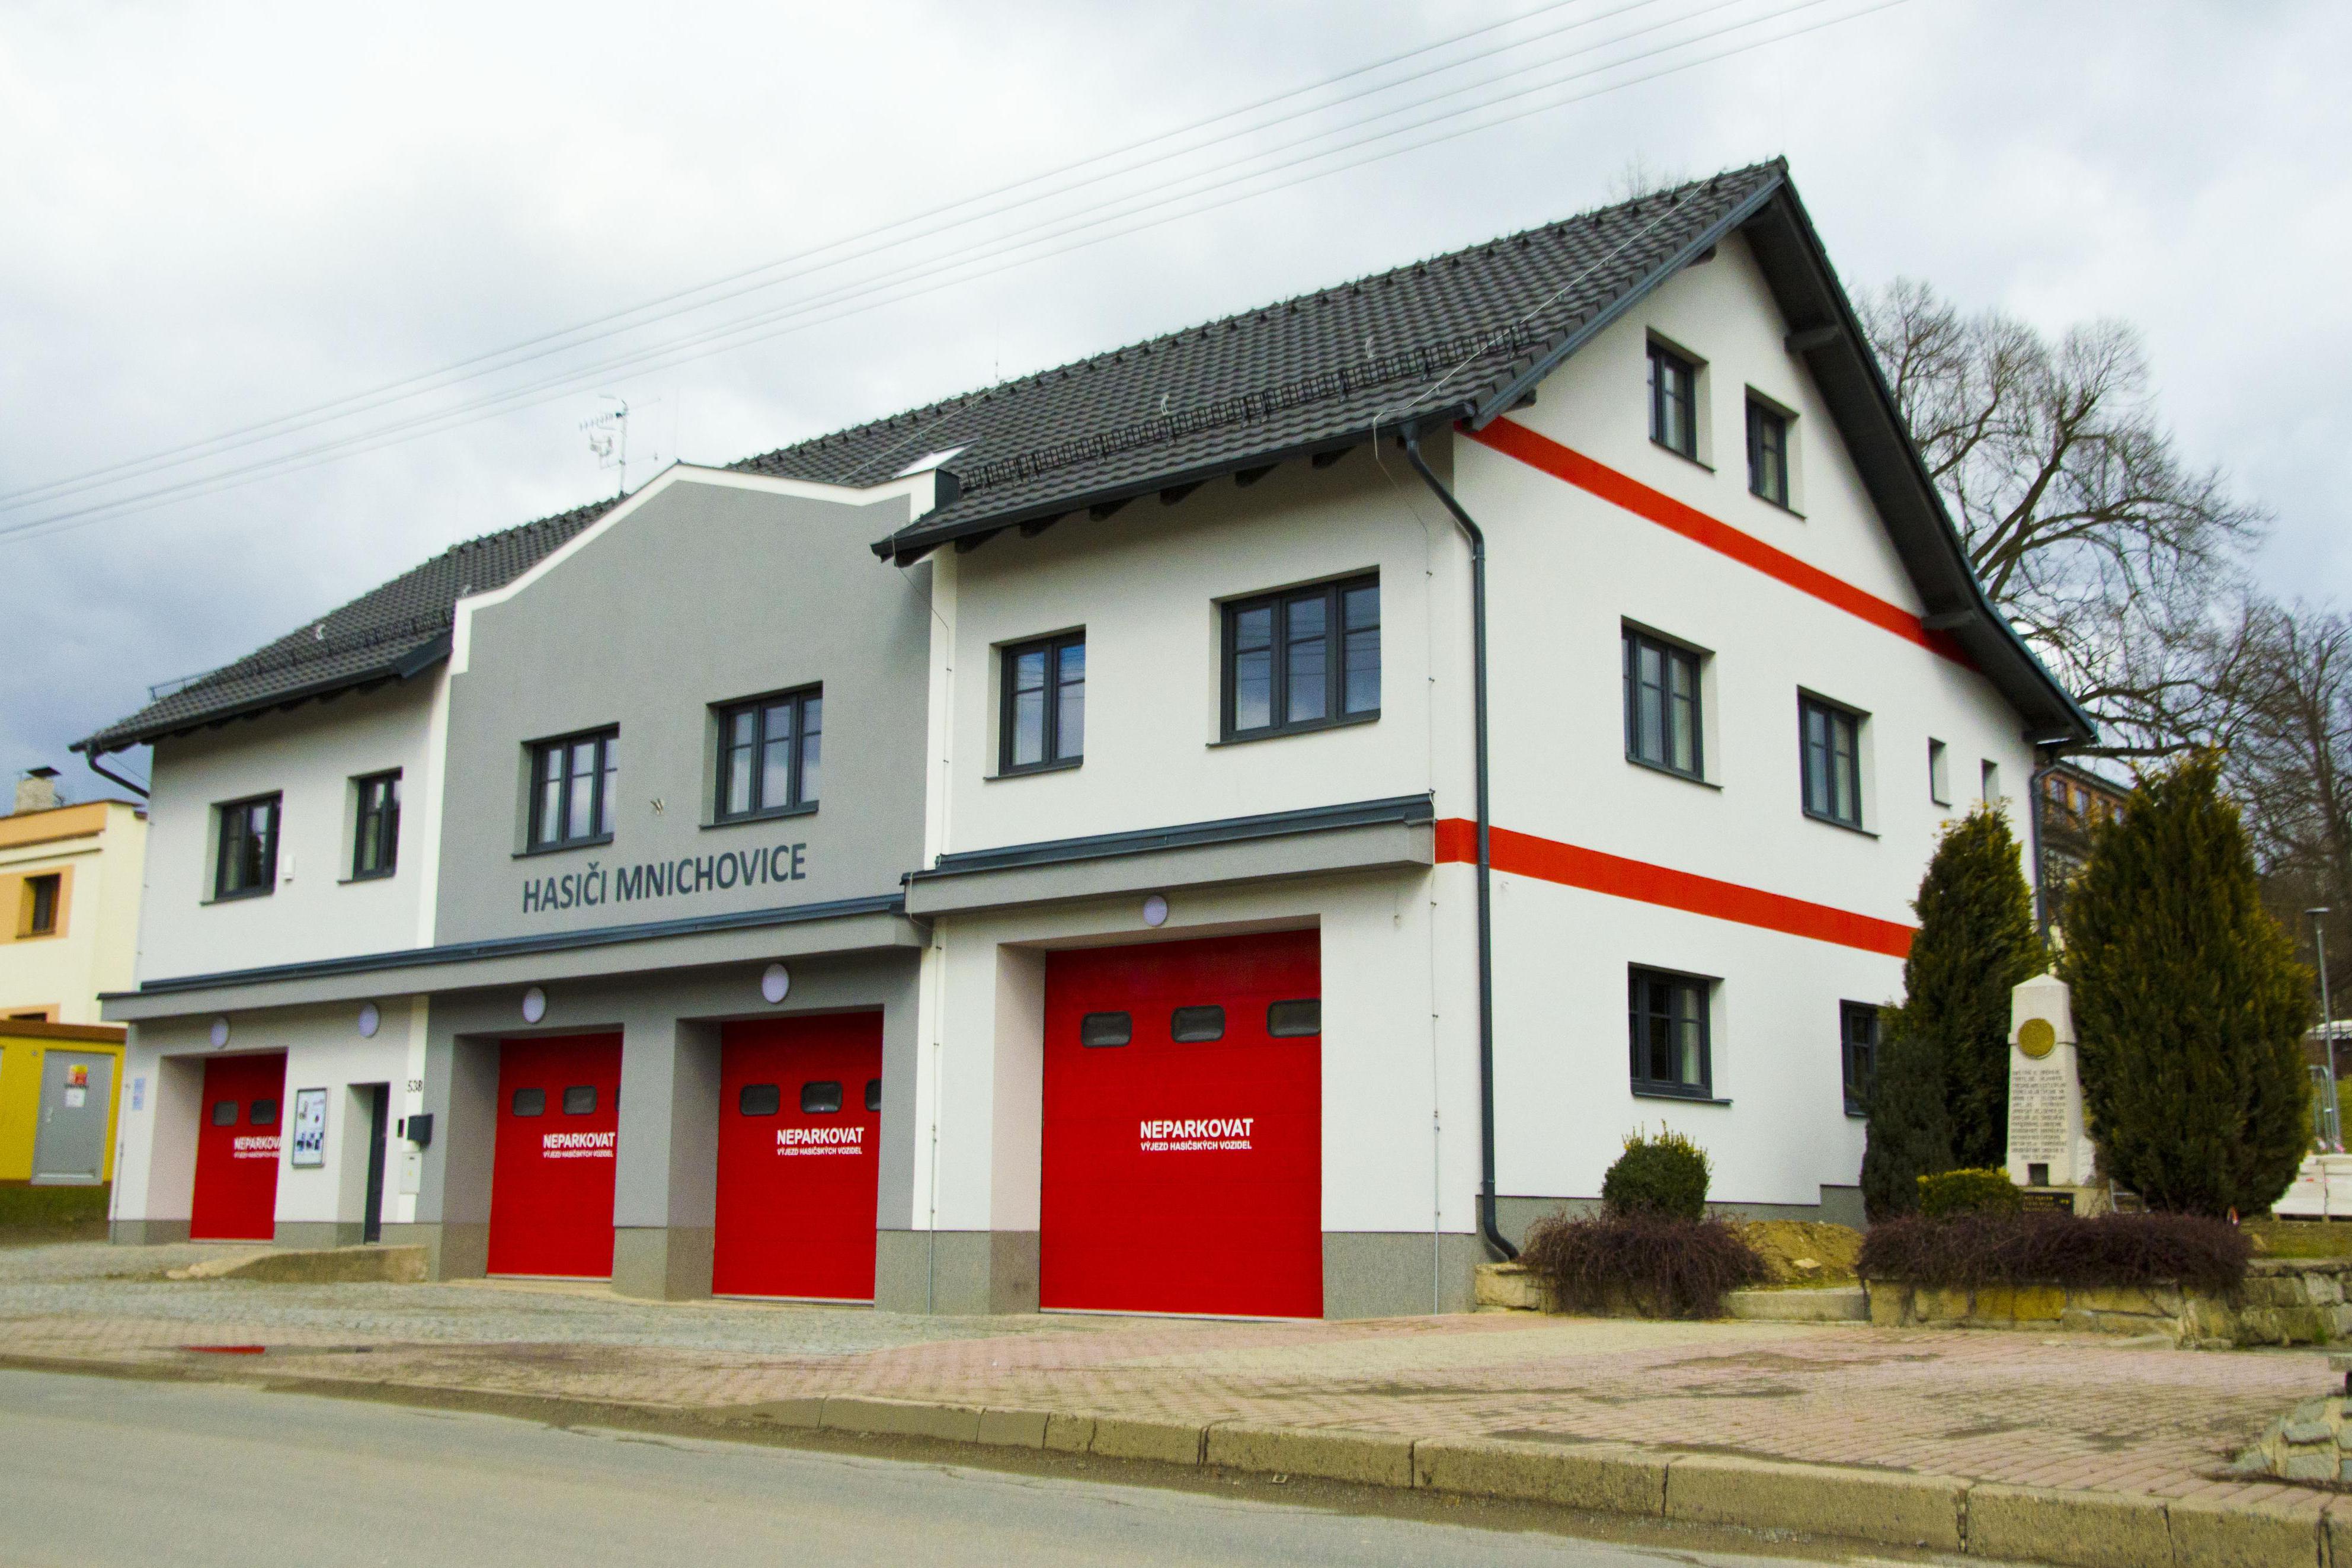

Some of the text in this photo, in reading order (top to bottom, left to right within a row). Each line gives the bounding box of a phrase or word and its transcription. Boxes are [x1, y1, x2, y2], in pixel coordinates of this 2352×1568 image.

[523, 843, 807, 913] HASIČI MNICHOVICE
[777, 1127, 865, 1144] NEPARKOVAT
[1140, 1118, 1253, 1138] NEPARKOVAT
[543, 1132, 615, 1148] NEPARKOVAT
[1140, 1140, 1252, 1151] VÝJEZD HASIČSKÝCH VOZIDEL
[777, 1145, 862, 1156] VÝJEZD HASIČSKÝCH VOZIDEL
